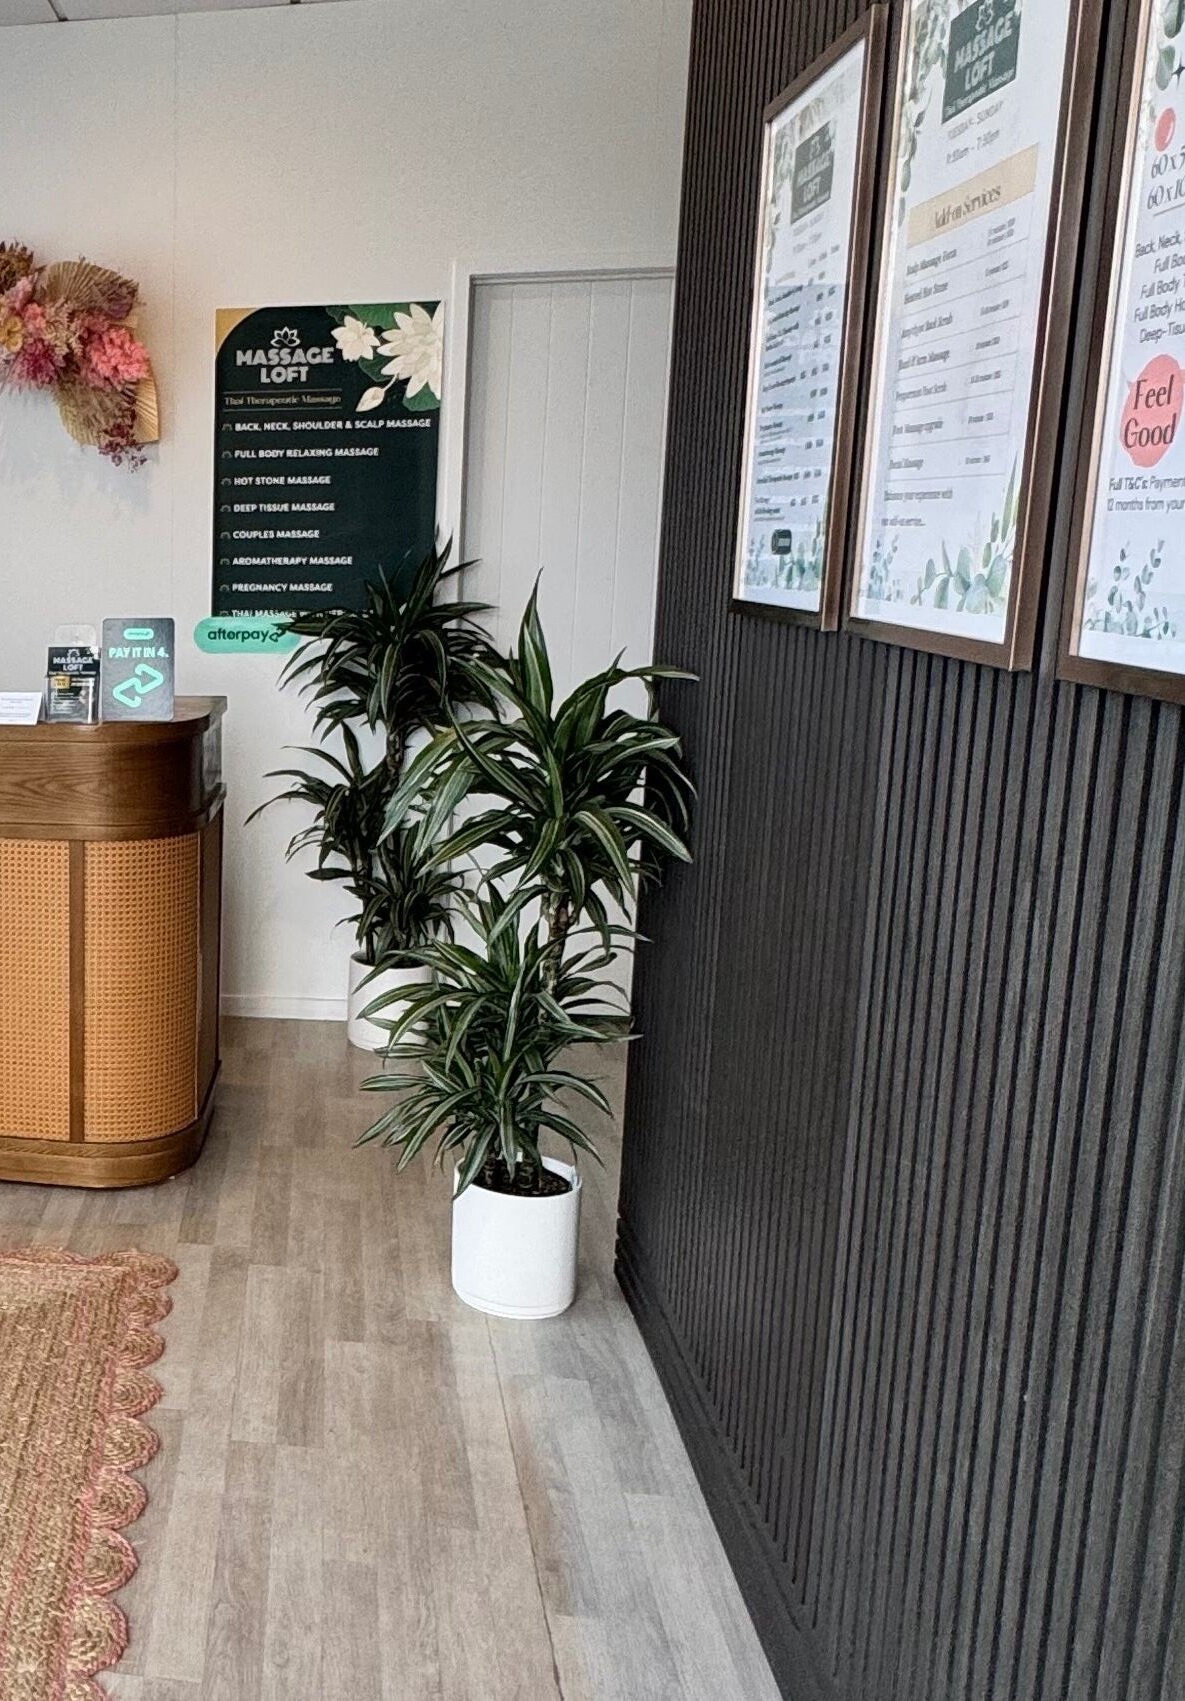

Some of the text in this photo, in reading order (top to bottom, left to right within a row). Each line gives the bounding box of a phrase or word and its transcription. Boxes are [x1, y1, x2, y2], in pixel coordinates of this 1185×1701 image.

[954, 9, 1014, 74] MASSAGE
[965, 50, 995, 91] LOFT
[1153, 255, 1170, 273] Full
[1140, 276, 1180, 299] Full Body
[1134, 305, 1149, 322] Full
[1150, 300, 1173, 319] Body
[236, 346, 335, 367] MASSAGE
[260, 366, 310, 384] LOFT
[1133, 374, 1175, 410] Feel
[224, 397, 245, 406] Thai
[292, 421, 343, 430] SHOULDER
[345, 420, 353, 429] &
[354, 420, 385, 429] SCALP
[386, 418, 431, 428] MASSAGE
[1124, 412, 1177, 449] Good
[234, 447, 379, 459] FULL BODY RELAXING MASSAGE
[234, 475, 331, 486] HOT STONE MASSAGE
[1109, 477, 1123, 491] Full
[233, 502, 335, 513] DEEP TISSUE MASSAGE
[1145, 496, 1165, 511] from
[232, 529, 320, 539] COUPLES MASSAGE
[232, 556, 353, 566] AROMATHERAPY MASSAGE
[232, 583, 333, 592] PREGNANCY MASSAGE
[207, 628, 269, 643] afterpay
[109, 647, 131, 658] PAY
[132, 647, 142, 658] IT
[143, 647, 156, 658] IN
[62, 664, 83, 672] LOFT
